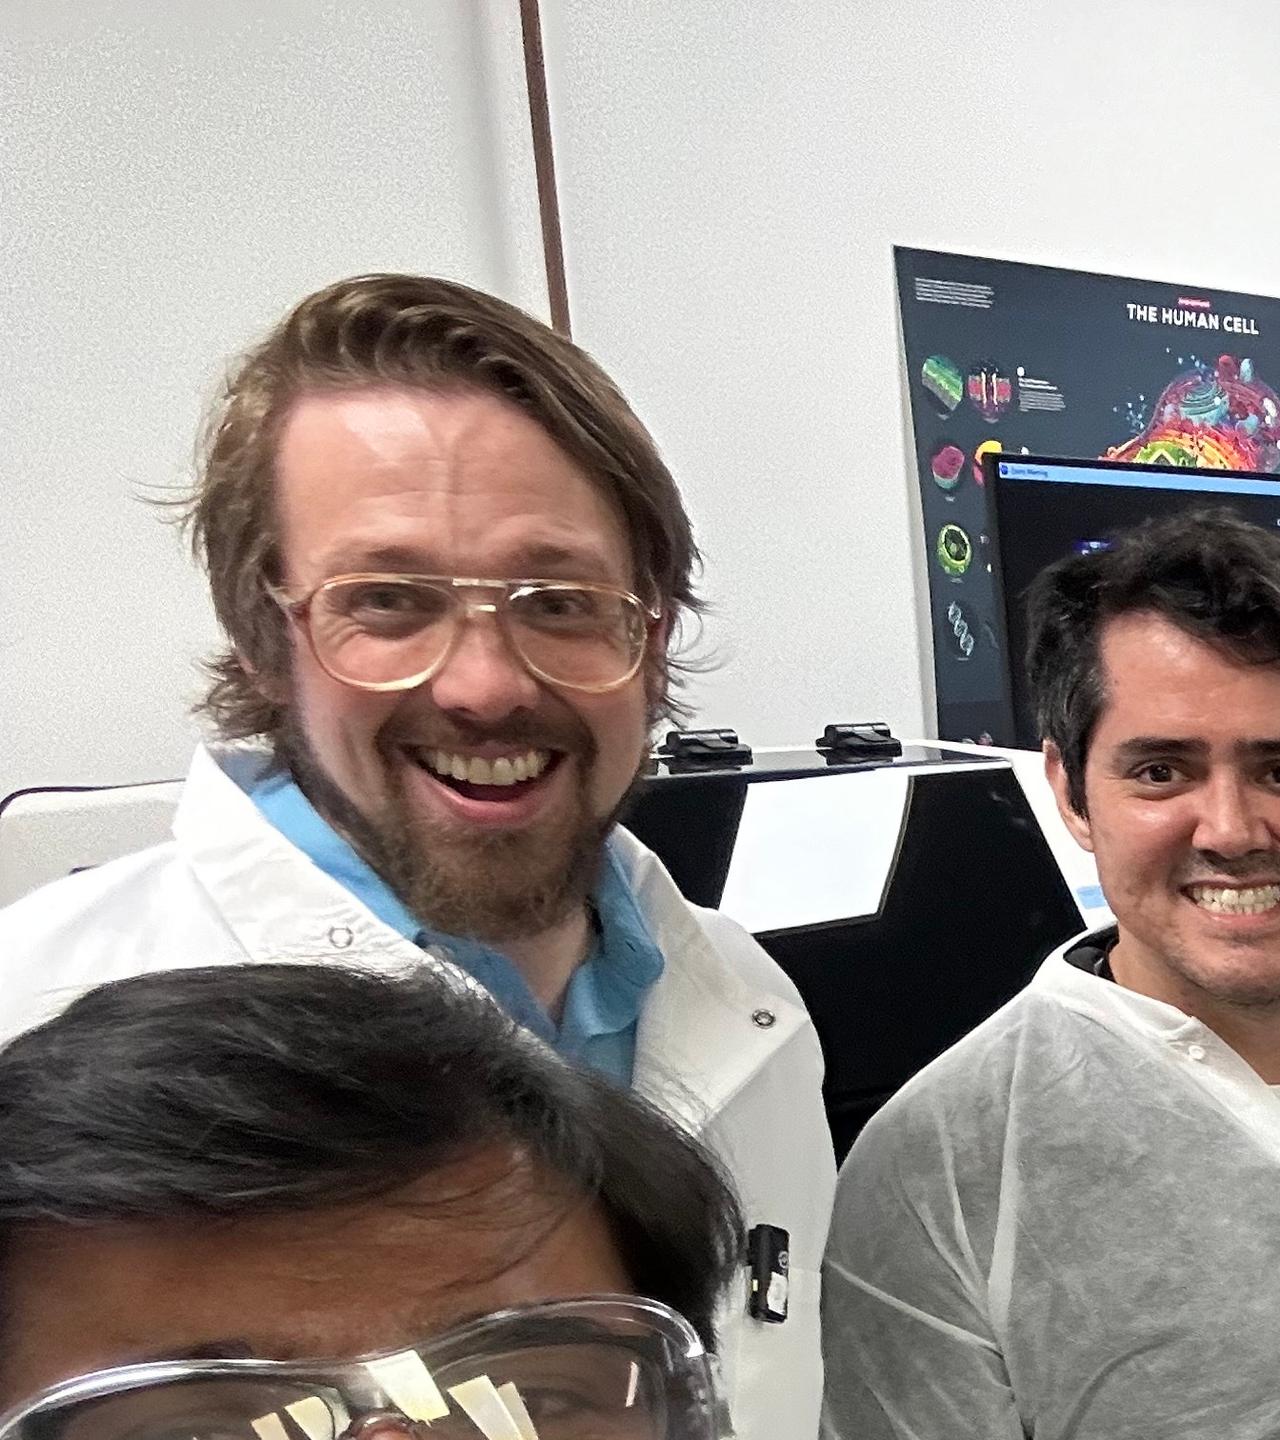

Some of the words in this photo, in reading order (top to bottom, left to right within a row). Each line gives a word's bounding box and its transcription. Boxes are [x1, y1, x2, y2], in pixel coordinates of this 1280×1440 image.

[1127, 303, 1158, 322] THE
[1162, 307, 1219, 330] HUMAN
[1223, 315, 1259, 335] CELL
